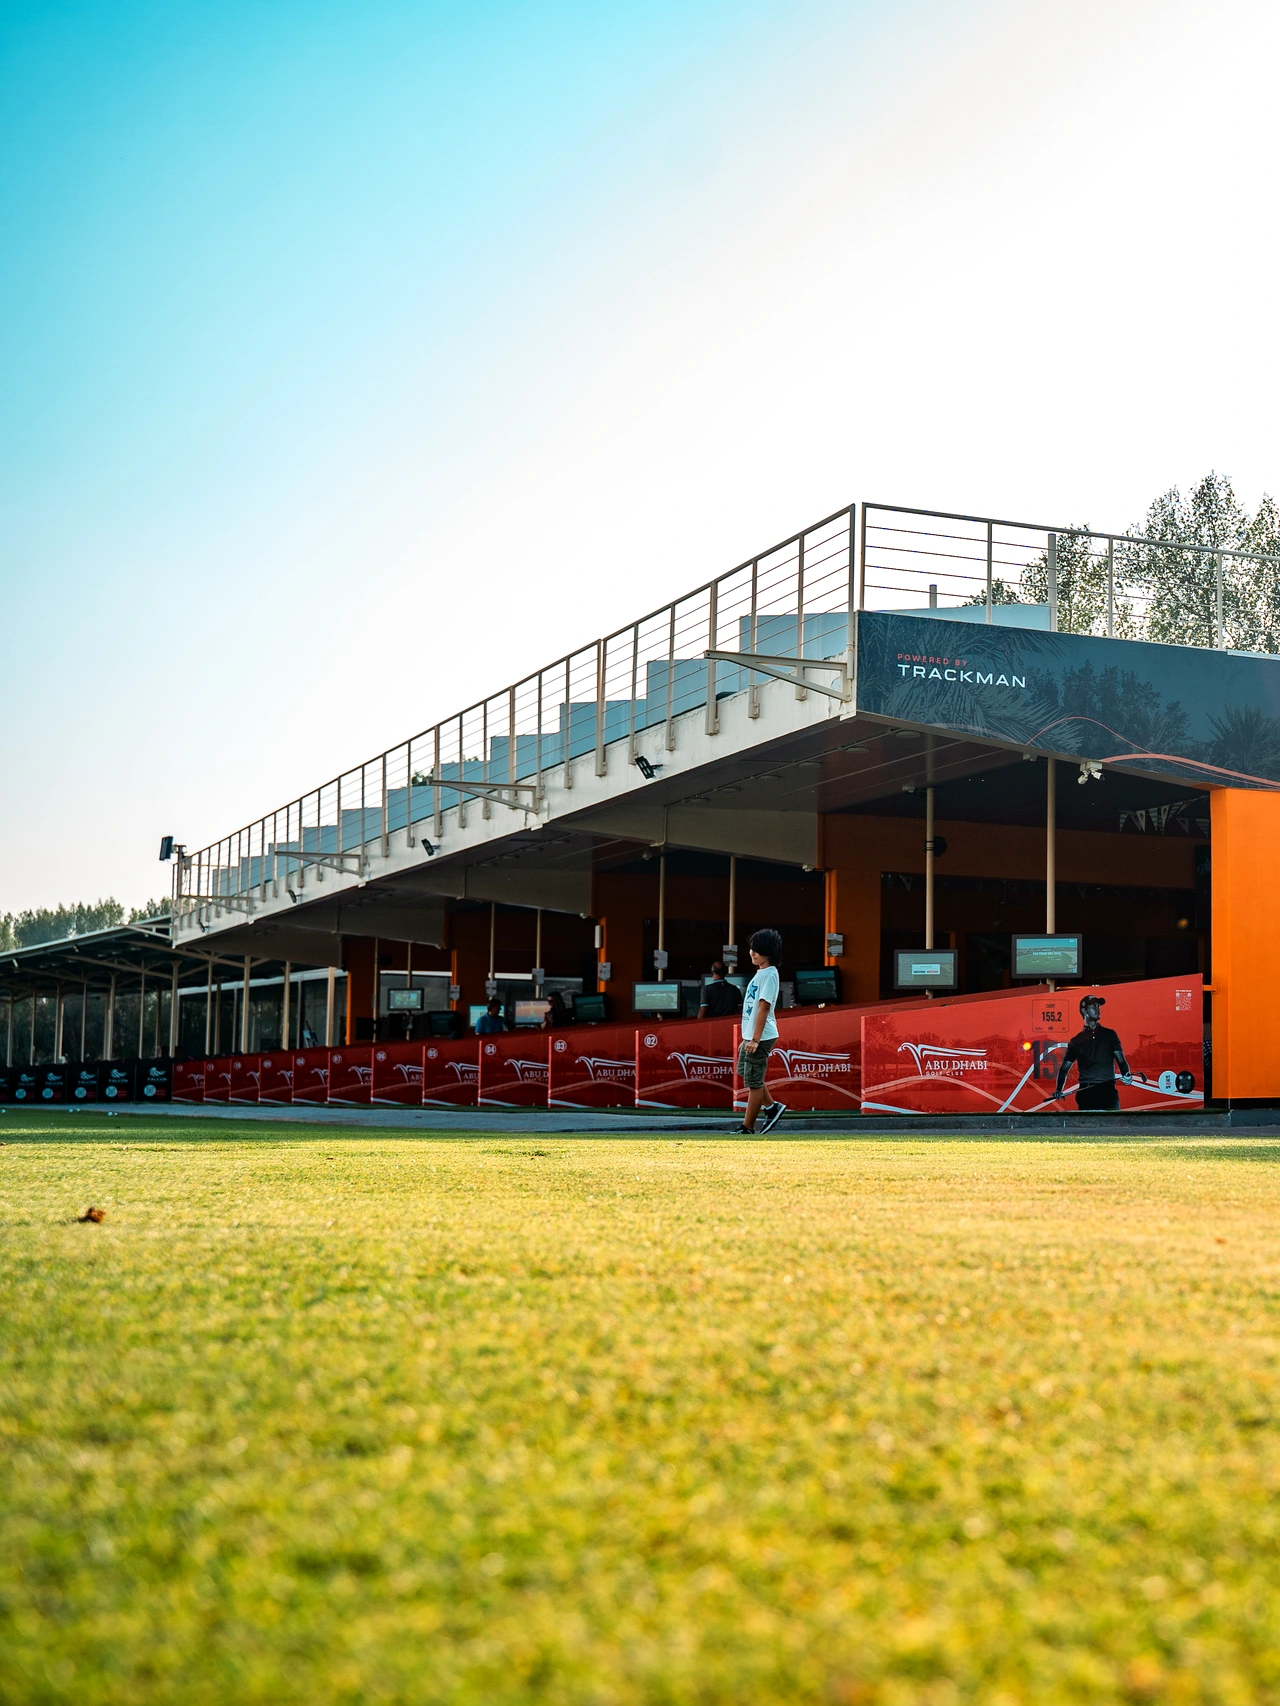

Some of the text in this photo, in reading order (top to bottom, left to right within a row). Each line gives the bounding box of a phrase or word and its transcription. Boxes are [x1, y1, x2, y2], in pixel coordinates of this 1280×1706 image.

[897, 653, 967, 667] POWERED BY
[897, 664, 1026, 688] TRACKMAN
[1041, 1011, 1063, 1022] 155.2
[1032, 1039, 1065, 1080] 15
[793, 1063, 851, 1073] ABU DHABI
[925, 1060, 988, 1070] ABU DHABI
[523, 1070, 541, 1078] ABU
[596, 1069, 615, 1077] ABU
[690, 1066, 711, 1075] ABU
